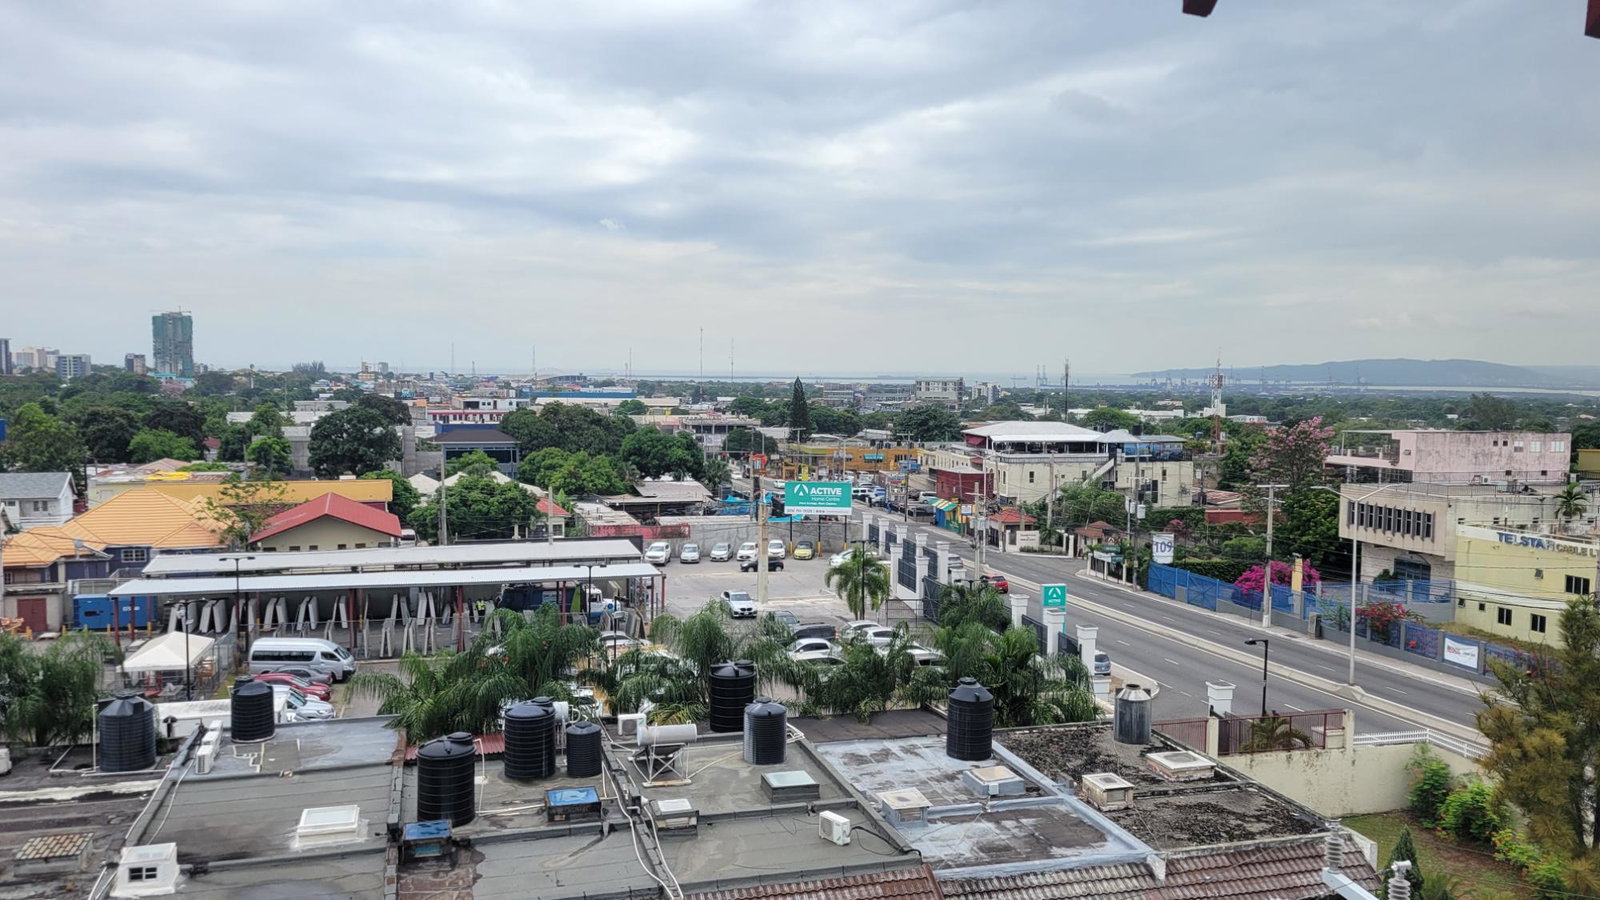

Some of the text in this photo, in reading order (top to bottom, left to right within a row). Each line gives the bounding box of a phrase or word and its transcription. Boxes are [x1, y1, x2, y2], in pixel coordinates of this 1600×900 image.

[810, 487, 842, 495] ACTIVE
[1154, 541, 1173, 553] 109
[1556, 543, 1588, 556] CABLE
